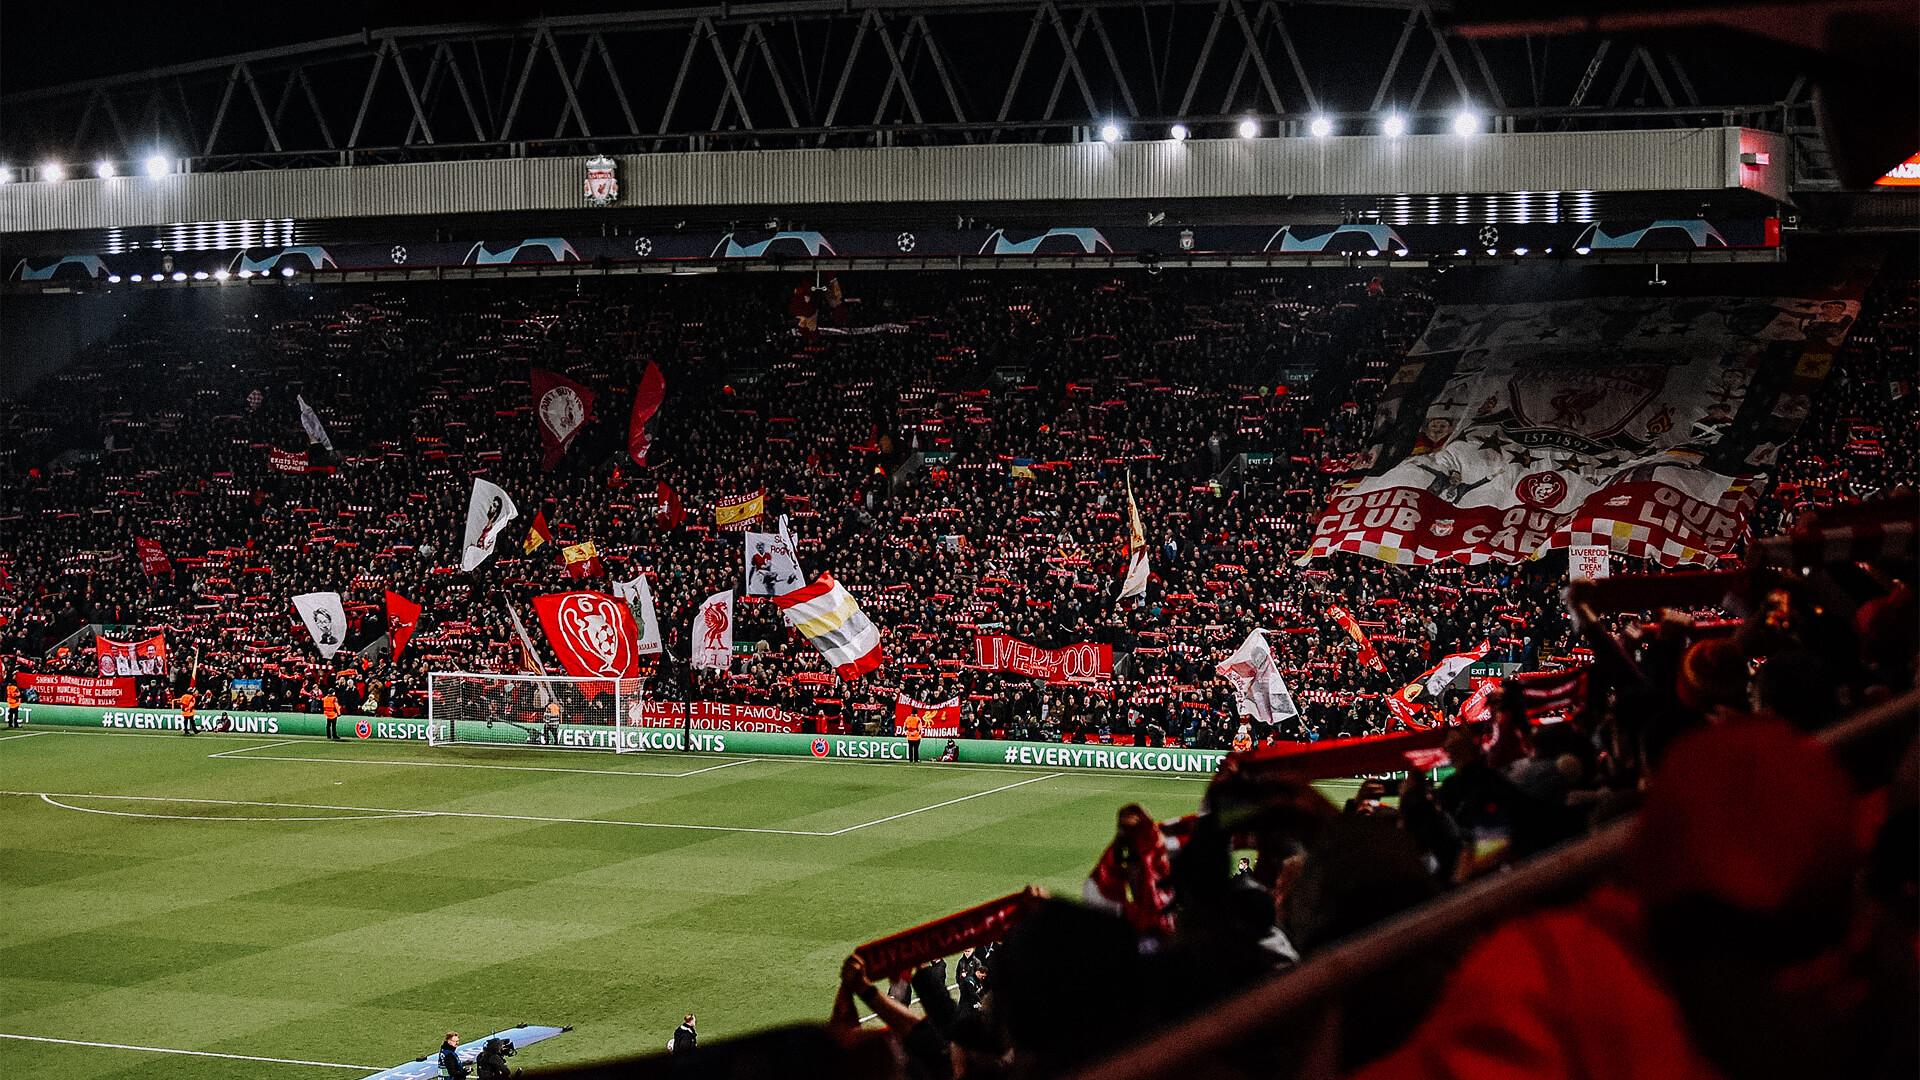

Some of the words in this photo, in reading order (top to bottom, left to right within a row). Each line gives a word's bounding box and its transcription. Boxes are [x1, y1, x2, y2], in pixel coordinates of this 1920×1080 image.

[1337, 489, 1420, 513] OUR
[1654, 487, 1737, 538] OUR
[1315, 507, 1422, 536] CLUB
[1570, 548, 1609, 557] LIVERPOOL
[1579, 563, 1602, 572] CREAM
[975, 637, 1112, 679] LIVERPOOL
[644, 701, 666, 714] WE
[703, 702, 731, 716] THE
[735, 706, 793, 723] FAMOUS
[377, 722, 447, 741] RESPECT
